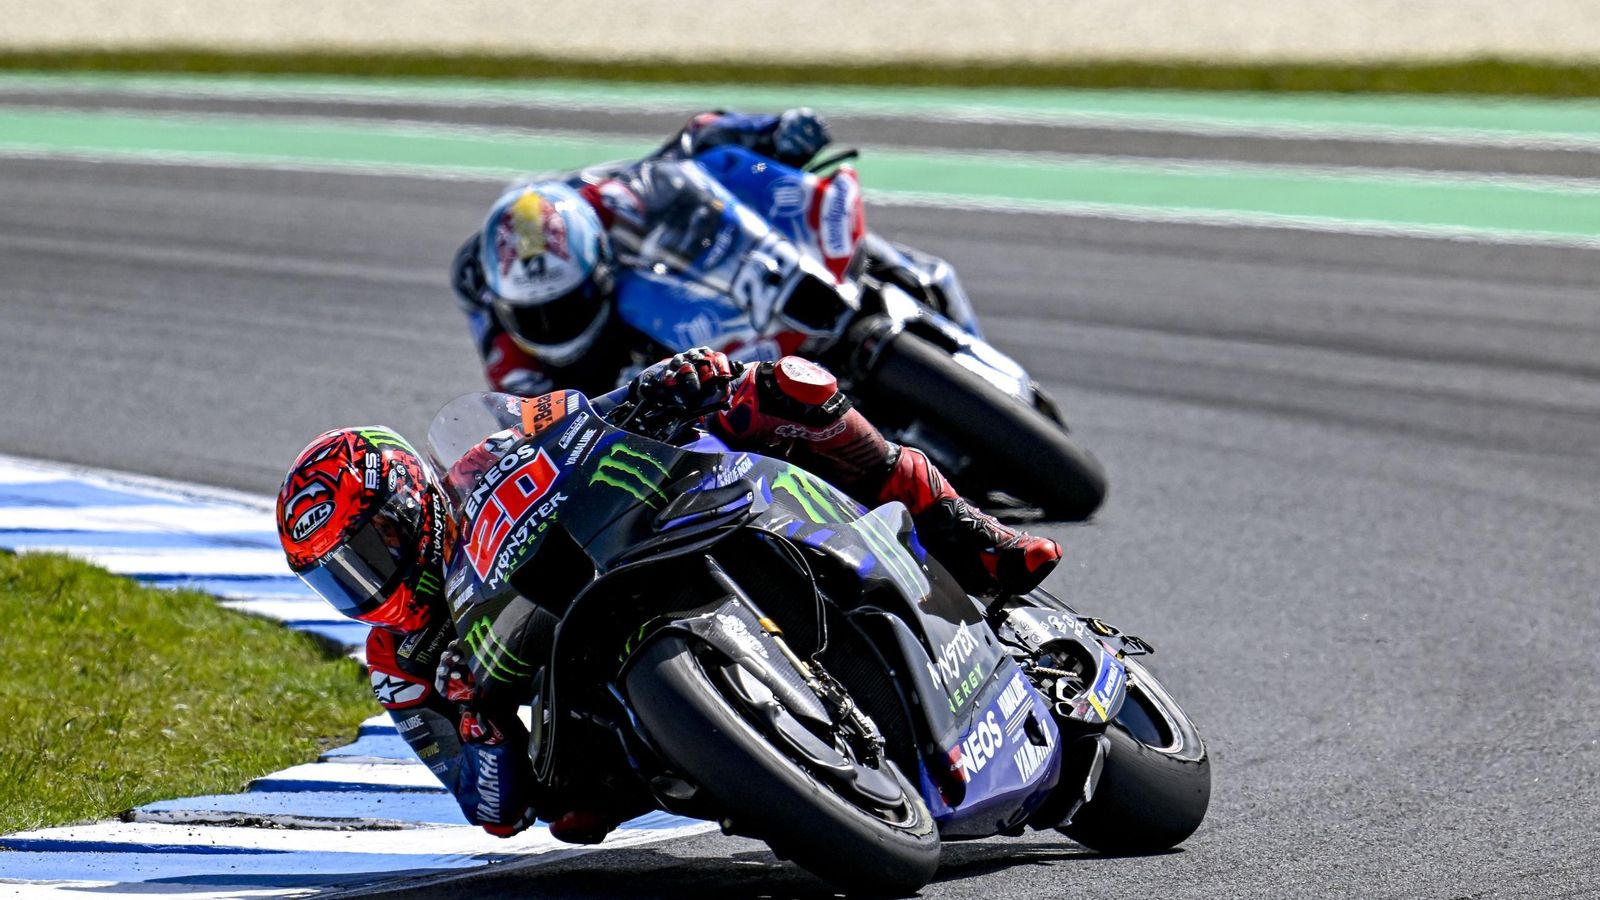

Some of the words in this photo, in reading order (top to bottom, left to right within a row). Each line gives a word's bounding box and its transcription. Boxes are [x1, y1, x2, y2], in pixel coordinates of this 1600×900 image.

[533, 393, 552, 423] Beta
[365, 452, 377, 489] BS
[464, 444, 535, 517] ENEOS
[564, 427, 597, 466] YAMALUBE
[294, 504, 328, 539] HJC
[464, 447, 560, 583] 20
[488, 491, 569, 590] MONSTER
[503, 511, 559, 583] ENERGY
[927, 619, 979, 690] MNSTER
[948, 663, 984, 712] NERGY
[962, 711, 1003, 784] NEOS
[477, 750, 501, 823] YAMAHA
